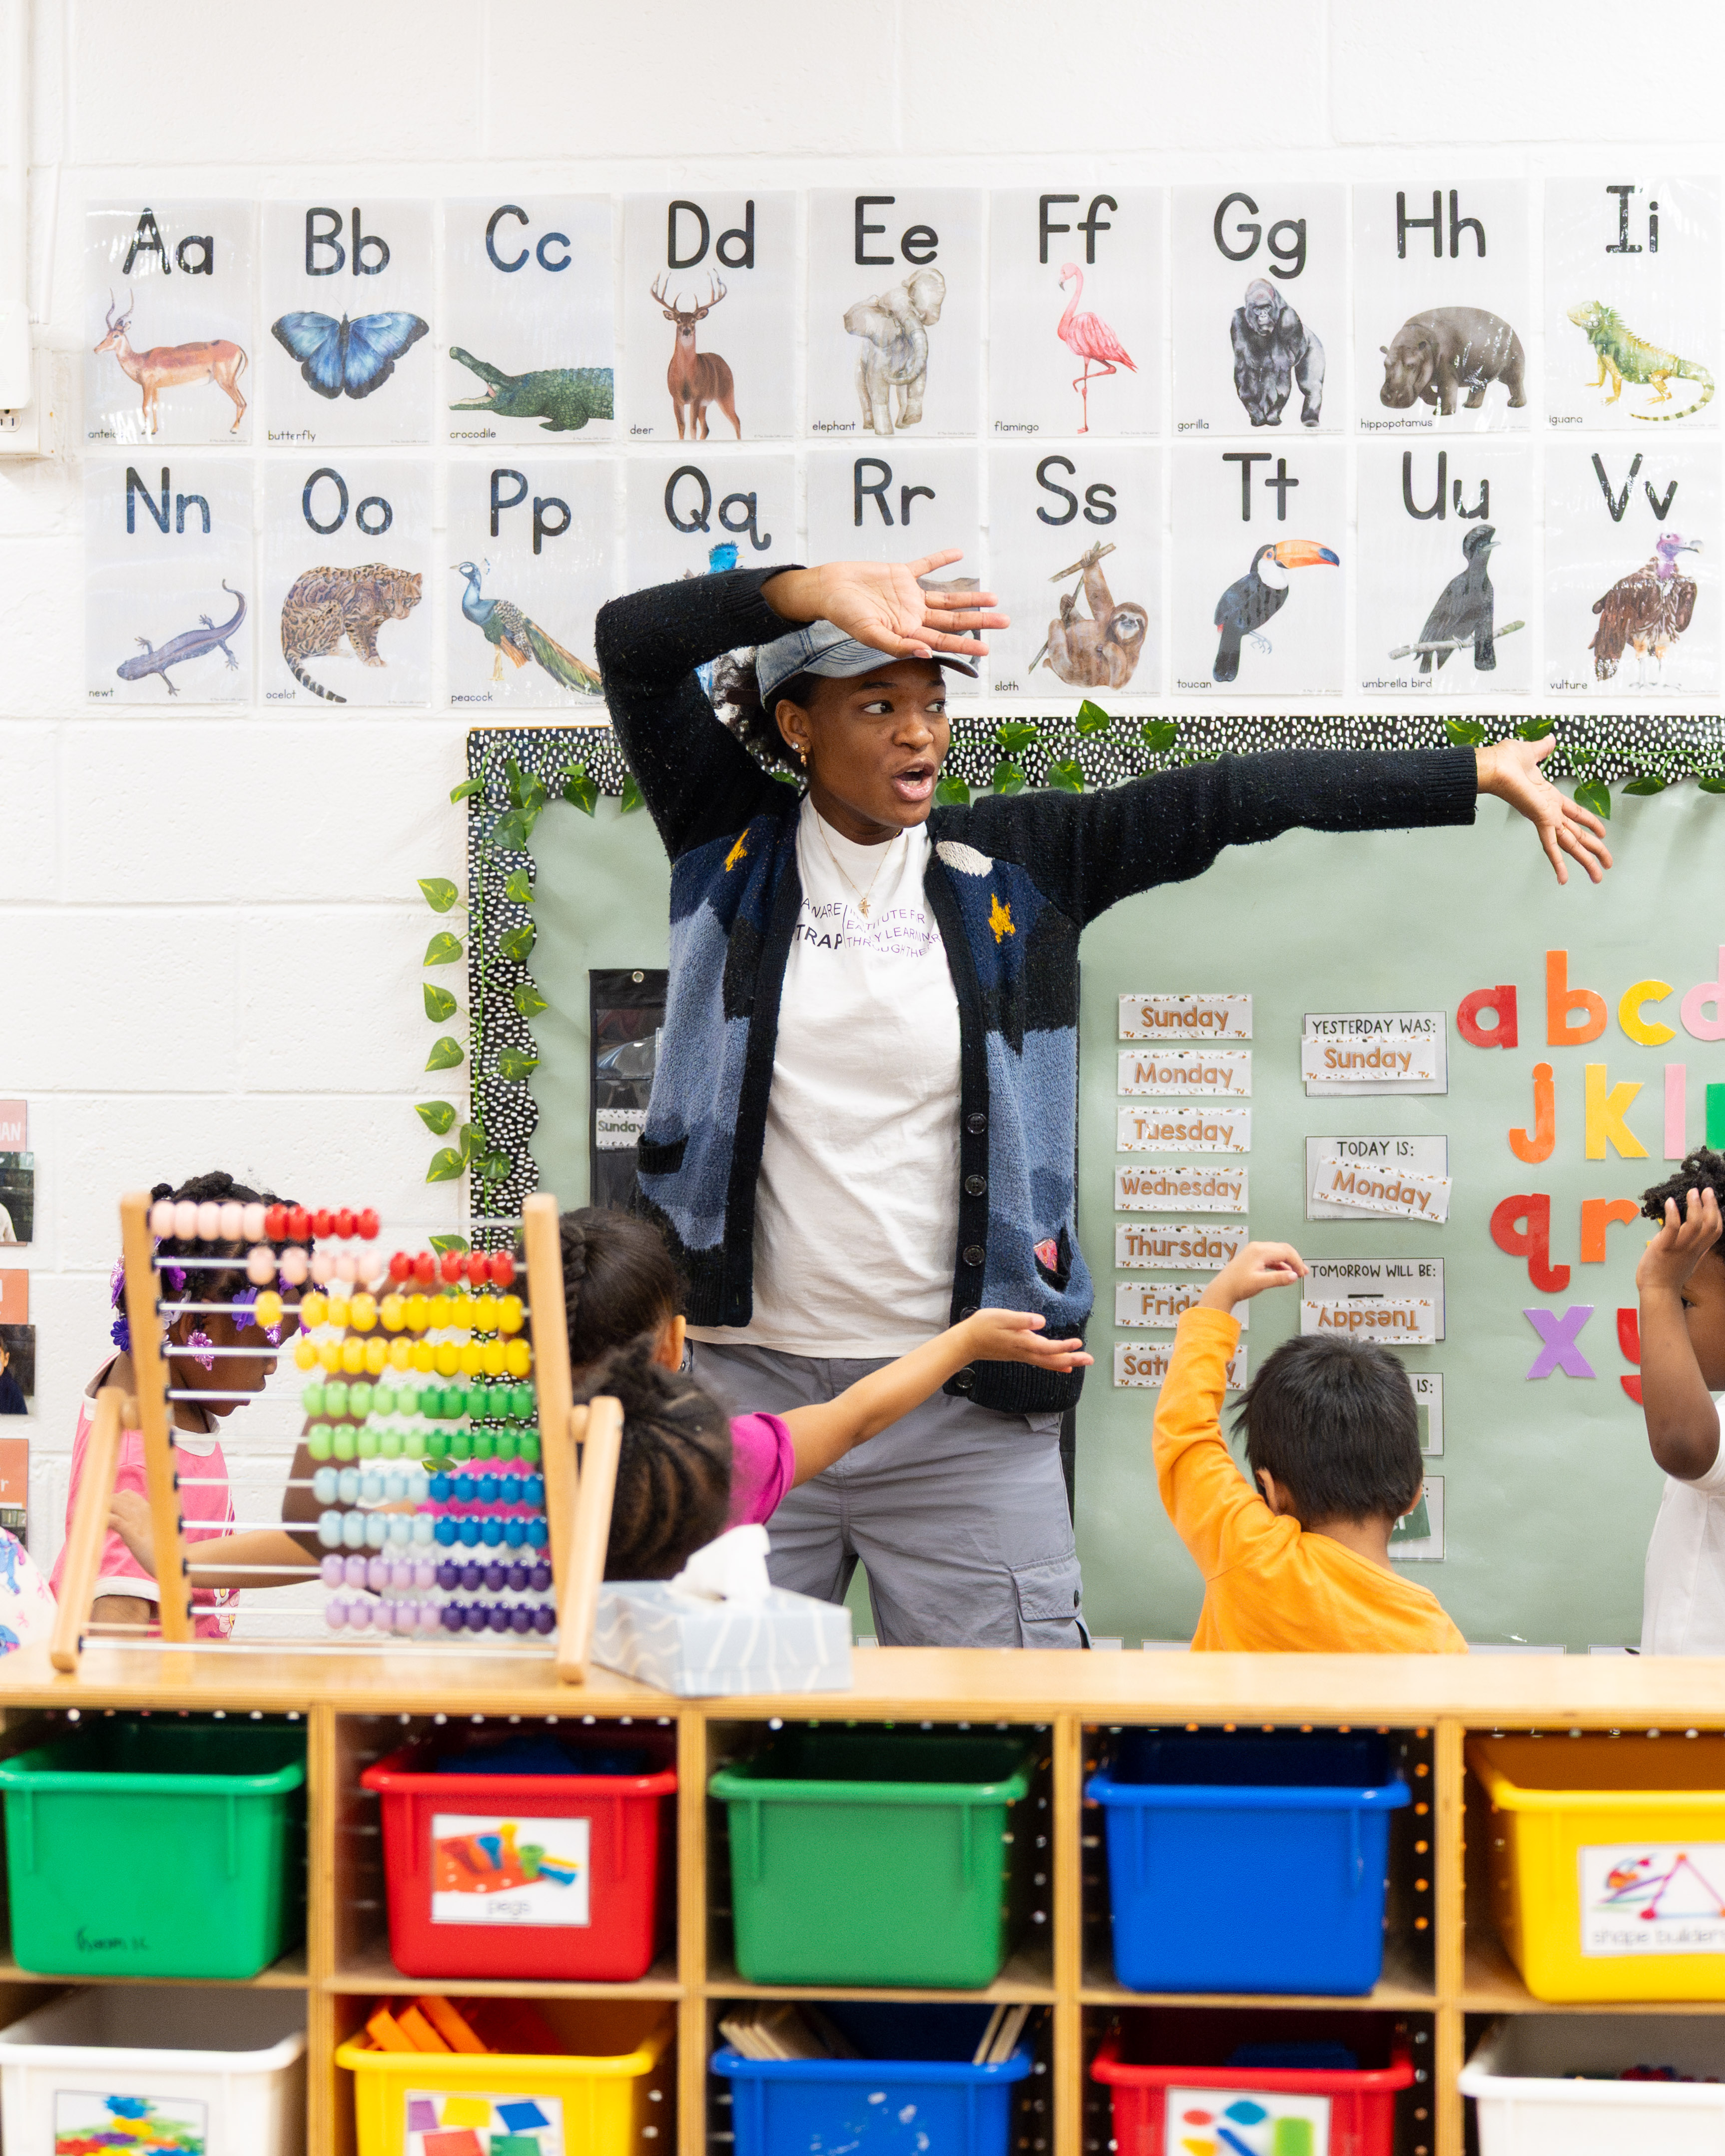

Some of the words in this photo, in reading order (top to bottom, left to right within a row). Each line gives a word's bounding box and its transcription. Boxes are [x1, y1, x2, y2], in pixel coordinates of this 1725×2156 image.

[855, 196, 938, 265] Ee
[1040, 194, 1118, 264] Ff
[1396, 189, 1486, 259] Hh
[1606, 186, 1658, 253] Ii
[122, 208, 213, 275] Aa
[306, 207, 390, 276] Bb
[486, 205, 572, 272] Cc
[667, 200, 754, 269] Dd
[1214, 192, 1306, 279] Gg
[630, 424, 654, 435] deer
[812, 420, 856, 433] elephant
[994, 421, 1039, 434] flamingo
[1177, 419, 1209, 432] gorilla
[1360, 418, 1433, 432] hippopotamus
[1549, 415, 1583, 426] iguana
[268, 430, 316, 442] butterfly
[450, 428, 497, 439] crocodile
[854, 458, 935, 527] Rr
[1036, 456, 1117, 526] Ss
[1222, 453, 1299, 522] Tt
[1403, 451, 1489, 520] Uu
[1592, 453, 1678, 522] Vv
[126, 467, 210, 534] Nn
[302, 468, 393, 535] Oo
[491, 469, 572, 555] Pp
[664, 466, 771, 550] Qq
[89, 687, 114, 697] newt
[266, 689, 296, 699] ocelot
[995, 680, 1019, 691] sloth
[1176, 679, 1212, 689] toucan
[1362, 677, 1407, 688] umbrella
[1411, 677, 1432, 688] bird
[1550, 679, 1588, 689] vulture
[451, 691, 493, 703] peacock
[796, 924, 843, 950] TRAP
[1141, 1005, 1229, 1031] Sunday
[1312, 1019, 1393, 1035] YESTERDAY
[1399, 1019, 1436, 1034] WAS:
[1324, 1047, 1412, 1072] Sunday
[1135, 1062, 1233, 1088] Monday
[0, 1121, 21, 1141] AN
[598, 1120, 644, 1134] Sunday
[1133, 1119, 1233, 1145] Tuesday
[1336, 1141, 1390, 1157] TODAY
[1397, 1141, 1414, 1156] IS:
[1120, 1177, 1241, 1200] Wednesday
[1331, 1169, 1431, 1211] Monday
[1125, 1235, 1238, 1262] Thursday
[1310, 1264, 1381, 1278] TOMORROW
[1386, 1264, 1413, 1277] WILL
[1418, 1264, 1436, 1277] BE:
[1317, 1307, 1420, 1332] Tuesday
[1417, 1379, 1433, 1394] IS:
[487, 1899, 532, 1916] pegs
[1594, 1929, 1650, 1946] shape
